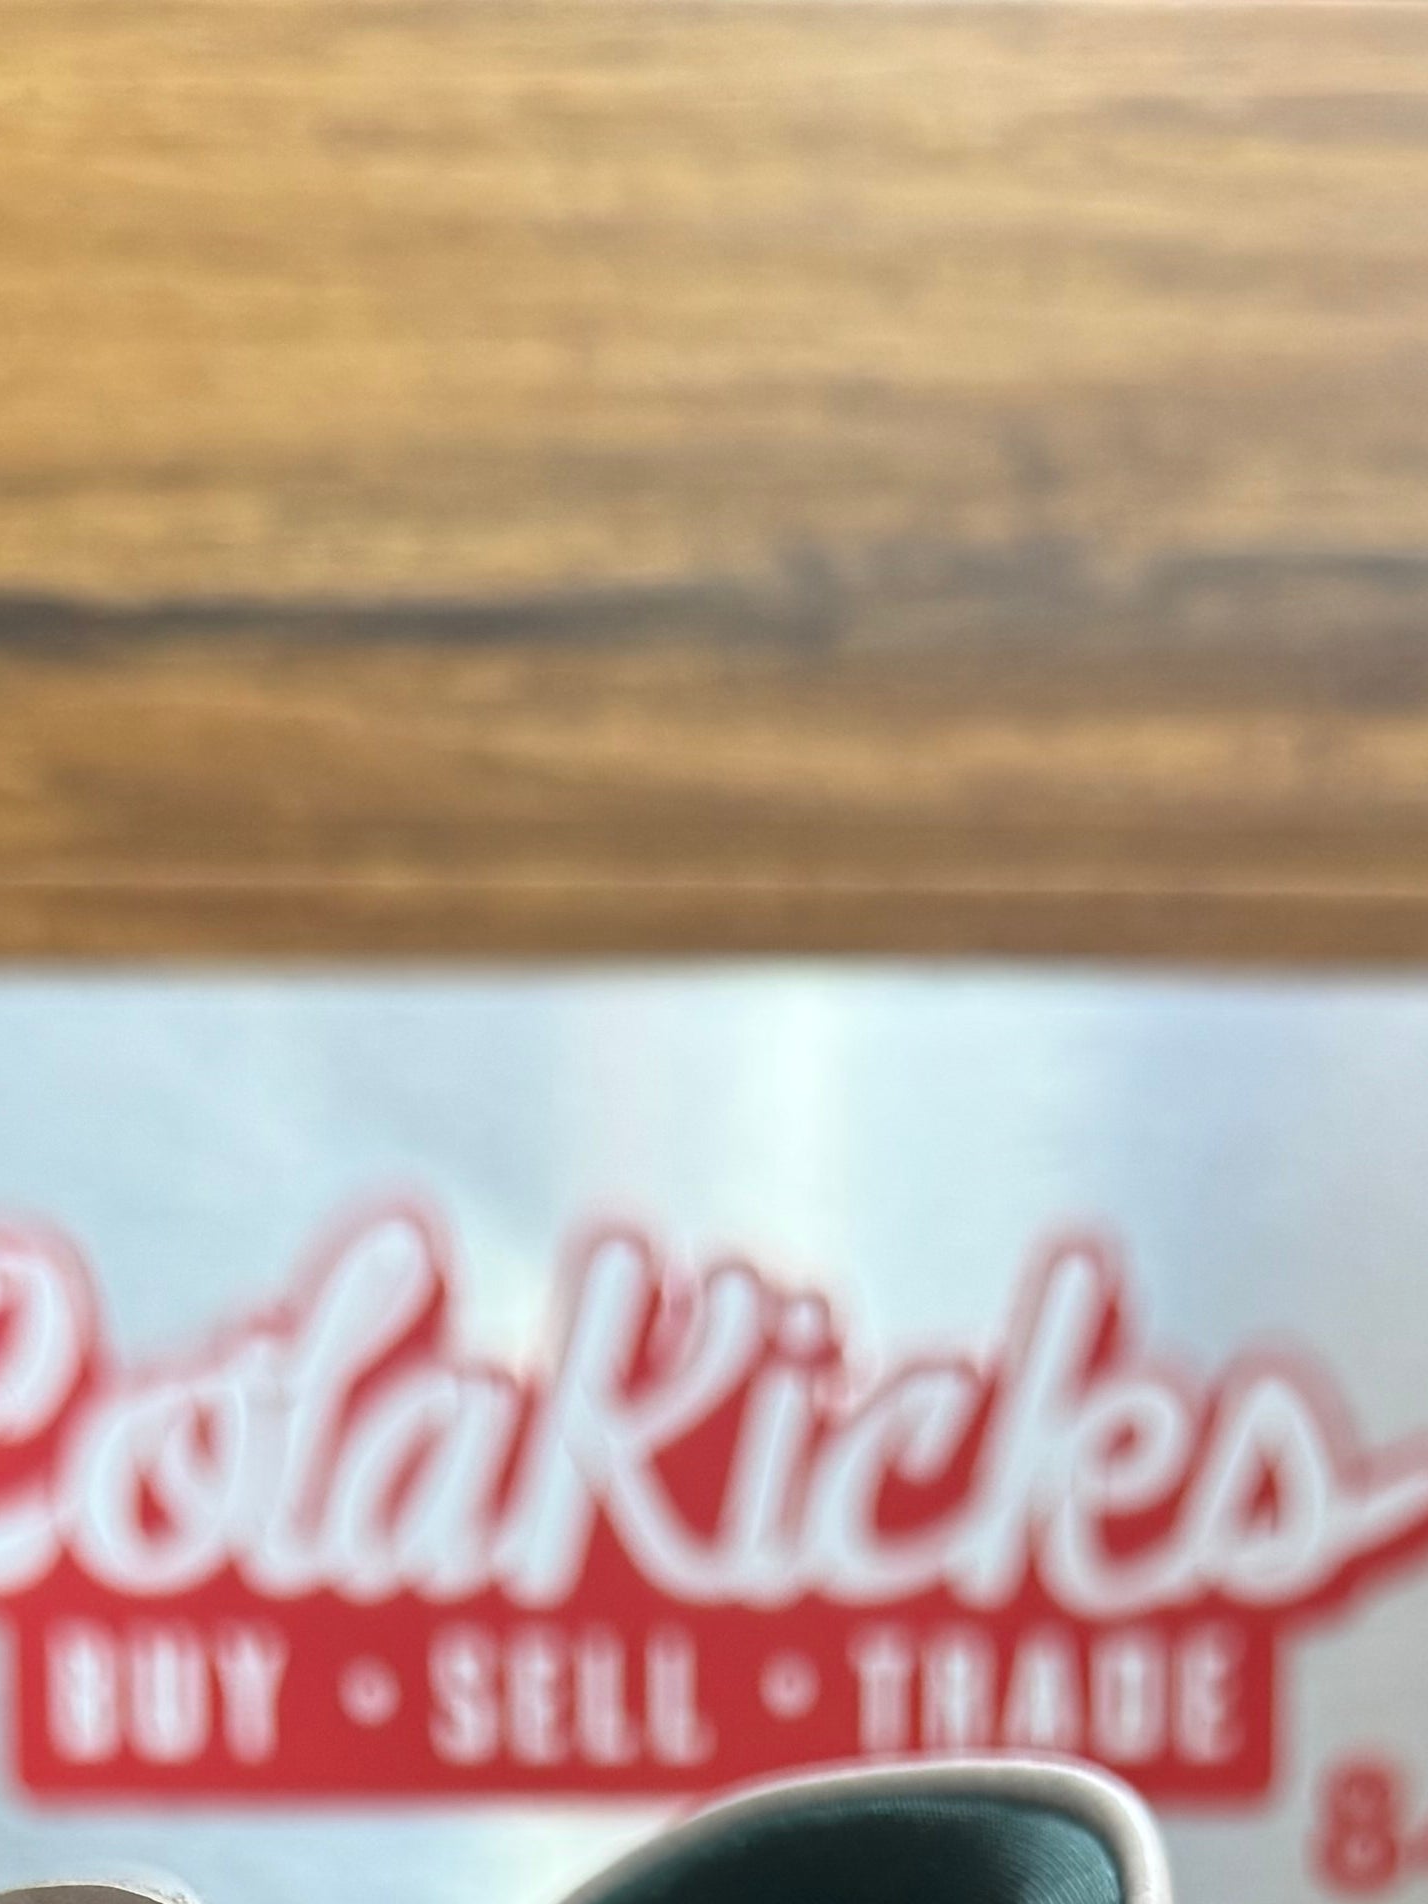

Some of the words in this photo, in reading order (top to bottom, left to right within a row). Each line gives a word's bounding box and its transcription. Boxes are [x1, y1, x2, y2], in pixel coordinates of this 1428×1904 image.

[44, 1620, 290, 1764] BUY
[422, 1620, 716, 1766] SELL
[846, 1618, 1244, 1766] TRADE
